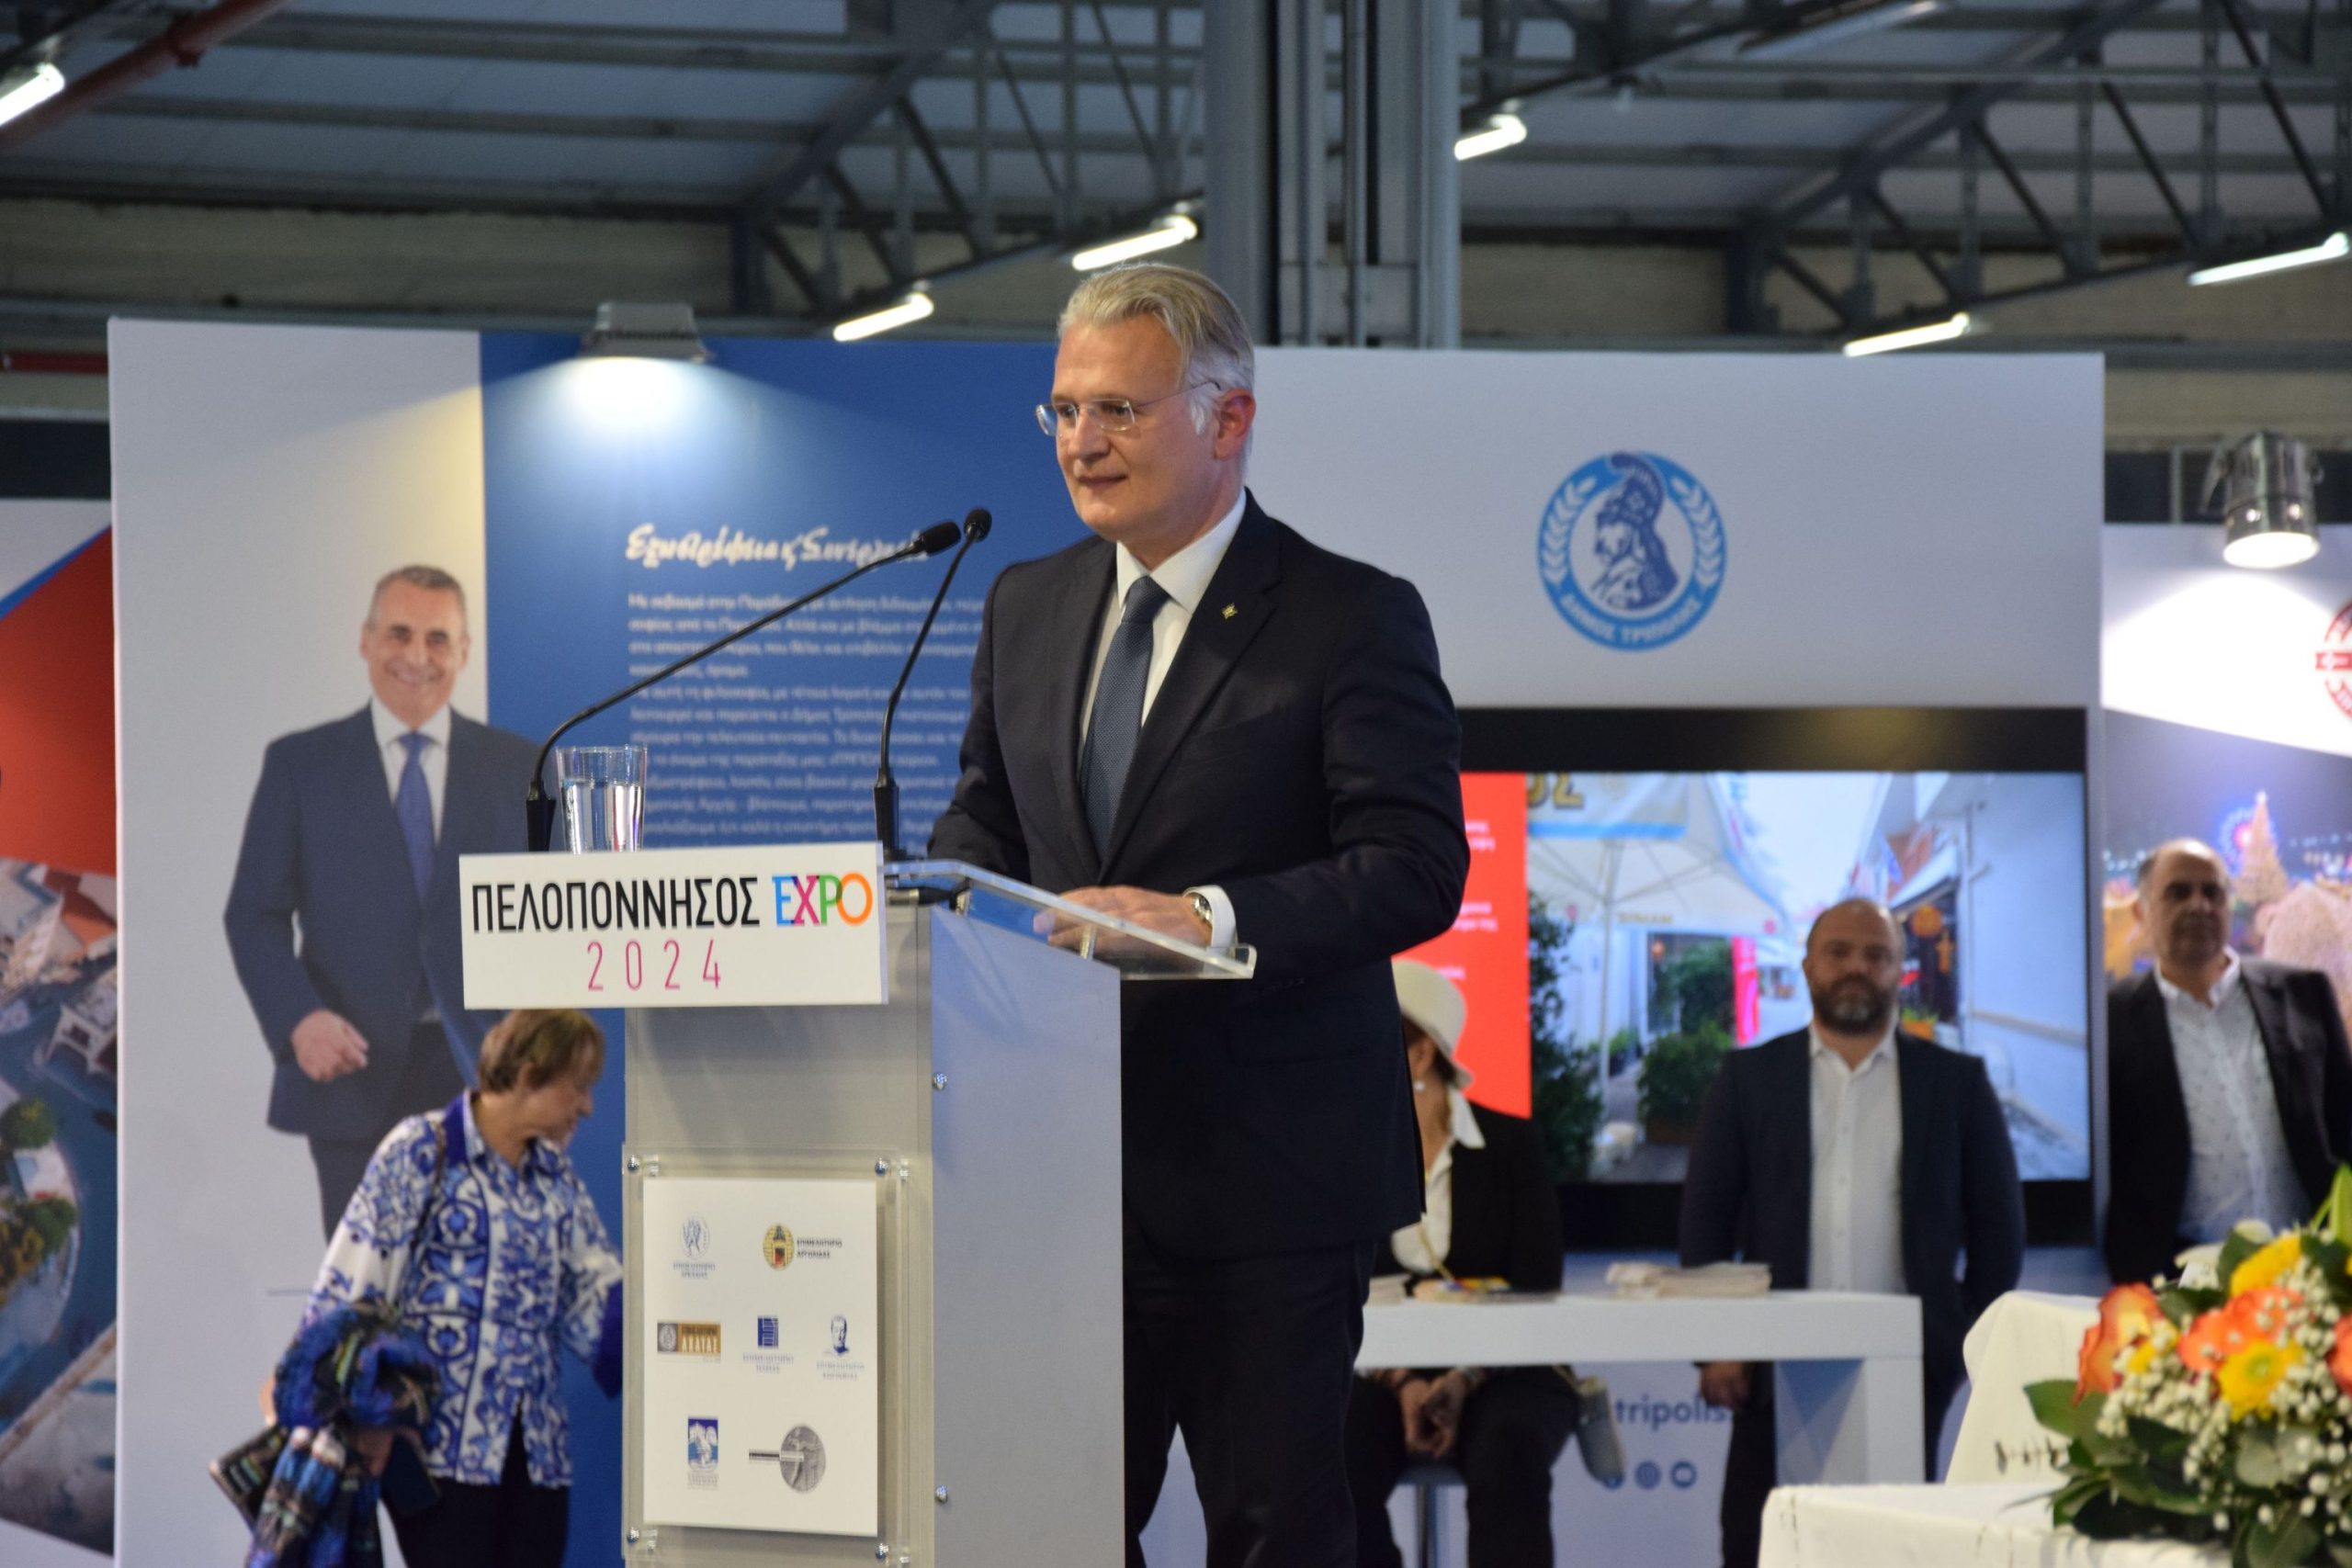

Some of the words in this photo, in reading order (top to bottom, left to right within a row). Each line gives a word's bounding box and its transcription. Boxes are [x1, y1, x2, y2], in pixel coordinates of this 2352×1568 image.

[472, 877, 760, 931] ΠΕΛΟΠΟΝΝΗΣΟΣ
[772, 872, 874, 927] EXPO
[586, 937, 721, 991] 2024
